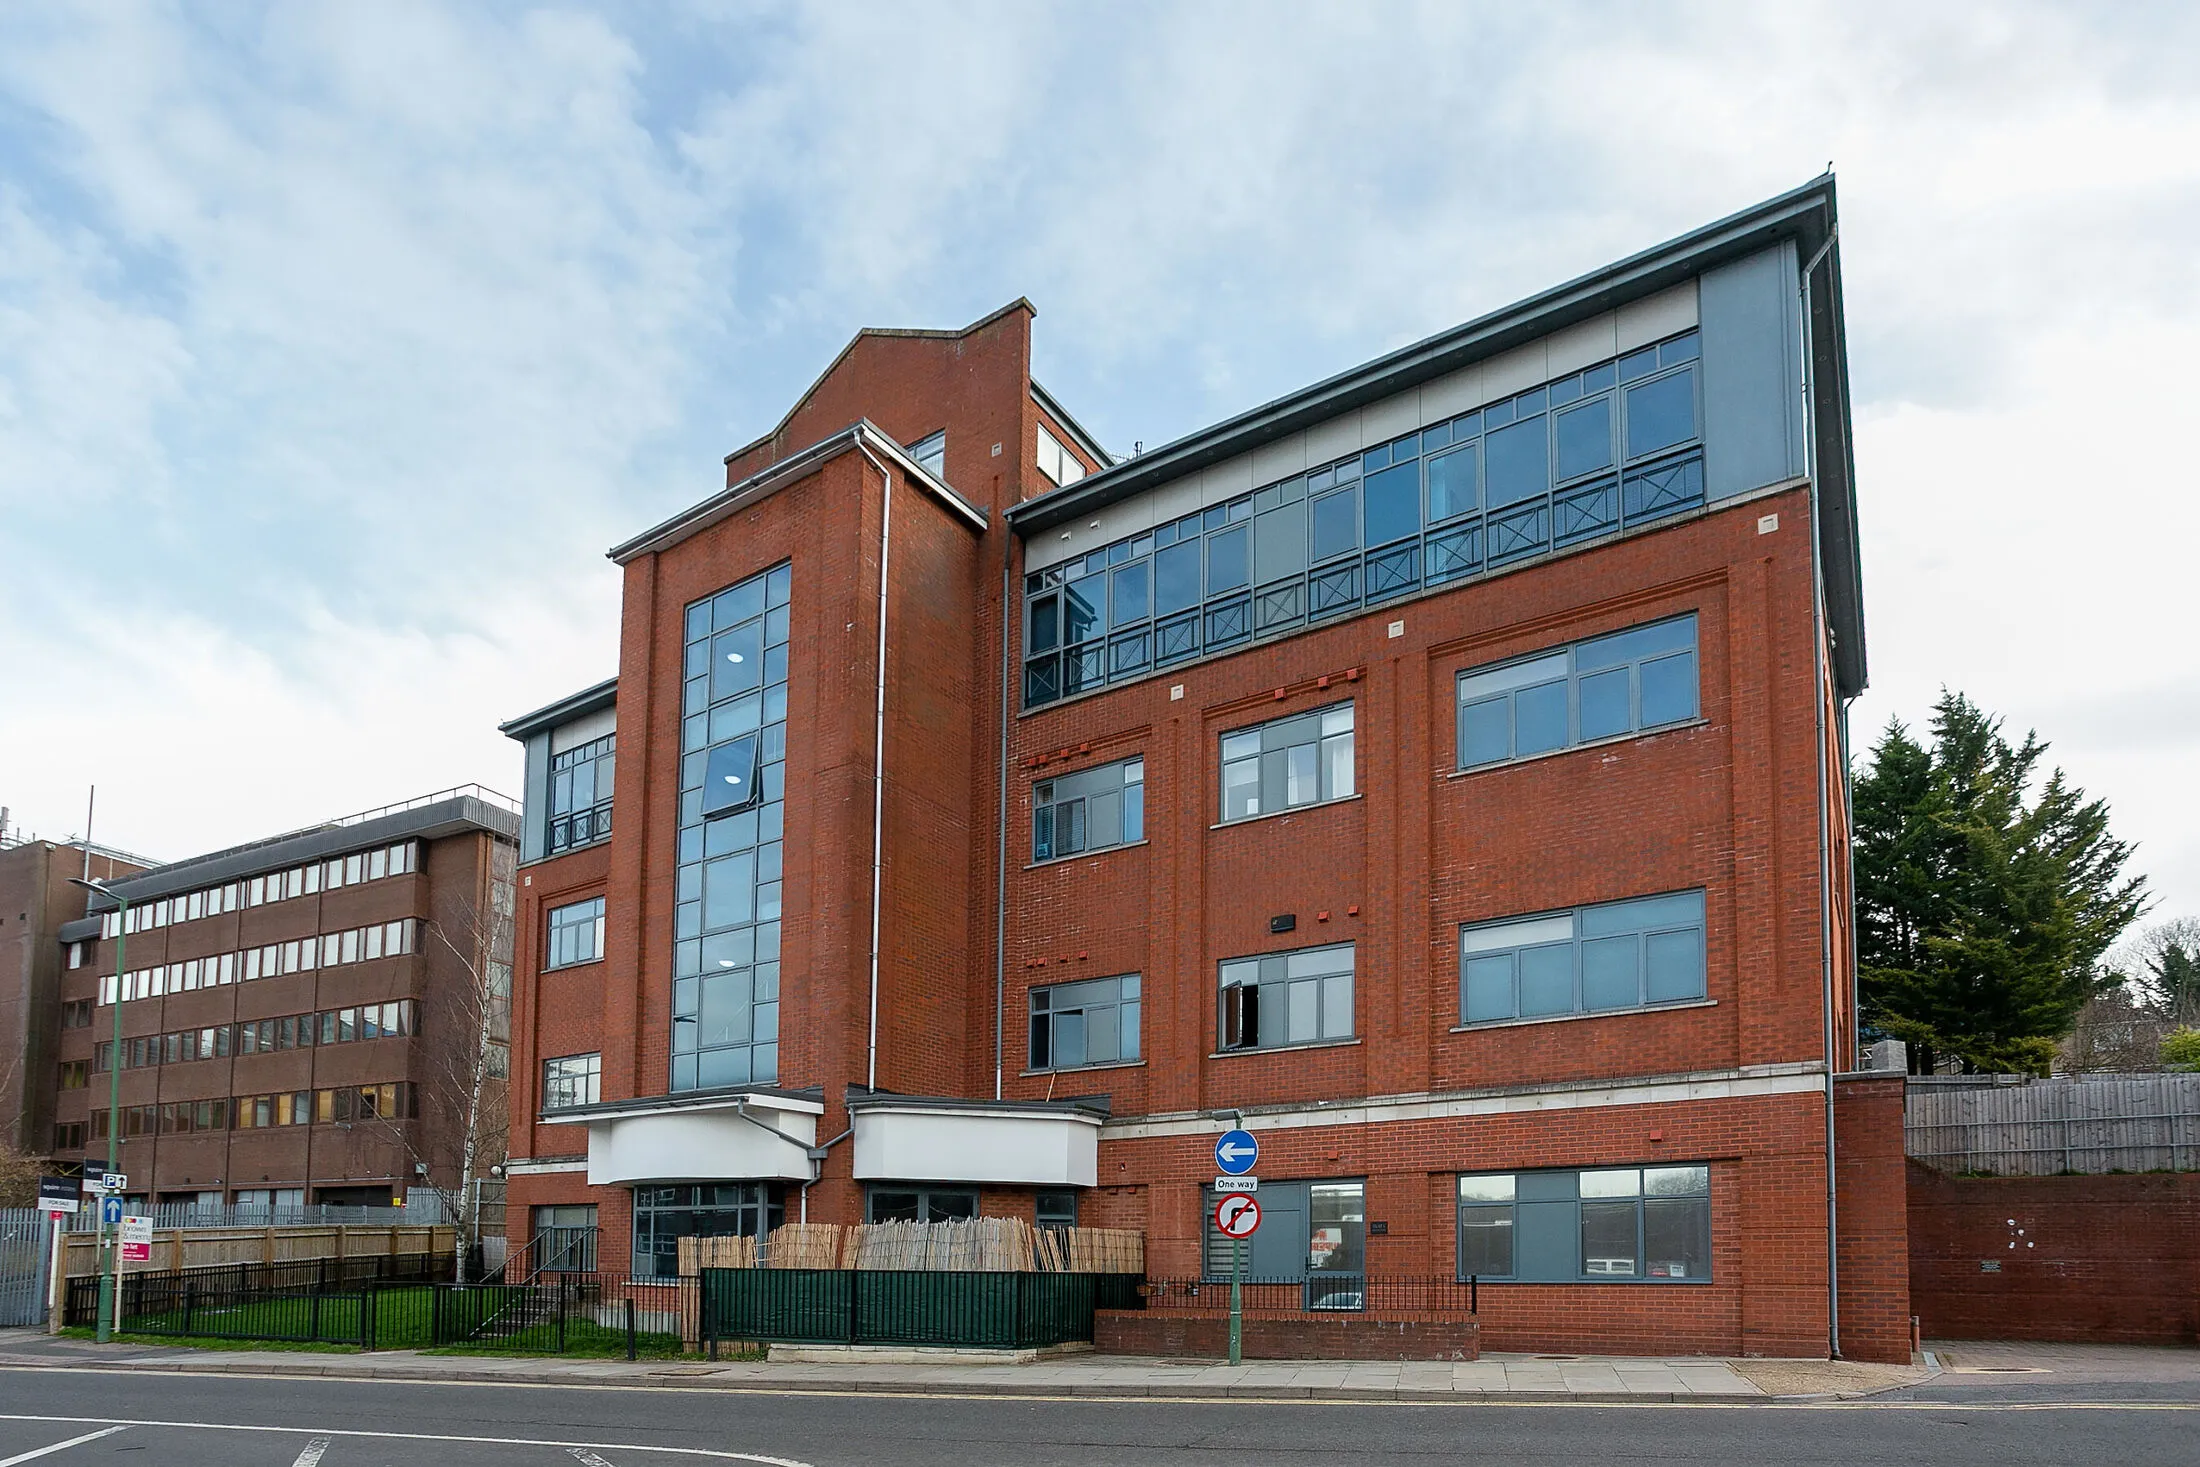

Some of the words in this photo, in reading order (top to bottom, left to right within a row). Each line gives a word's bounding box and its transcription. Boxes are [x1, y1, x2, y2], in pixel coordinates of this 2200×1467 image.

[107, 1177, 115, 1186] P
[1218, 1180, 1235, 1188] One
[1237, 1181, 1255, 1189] way
